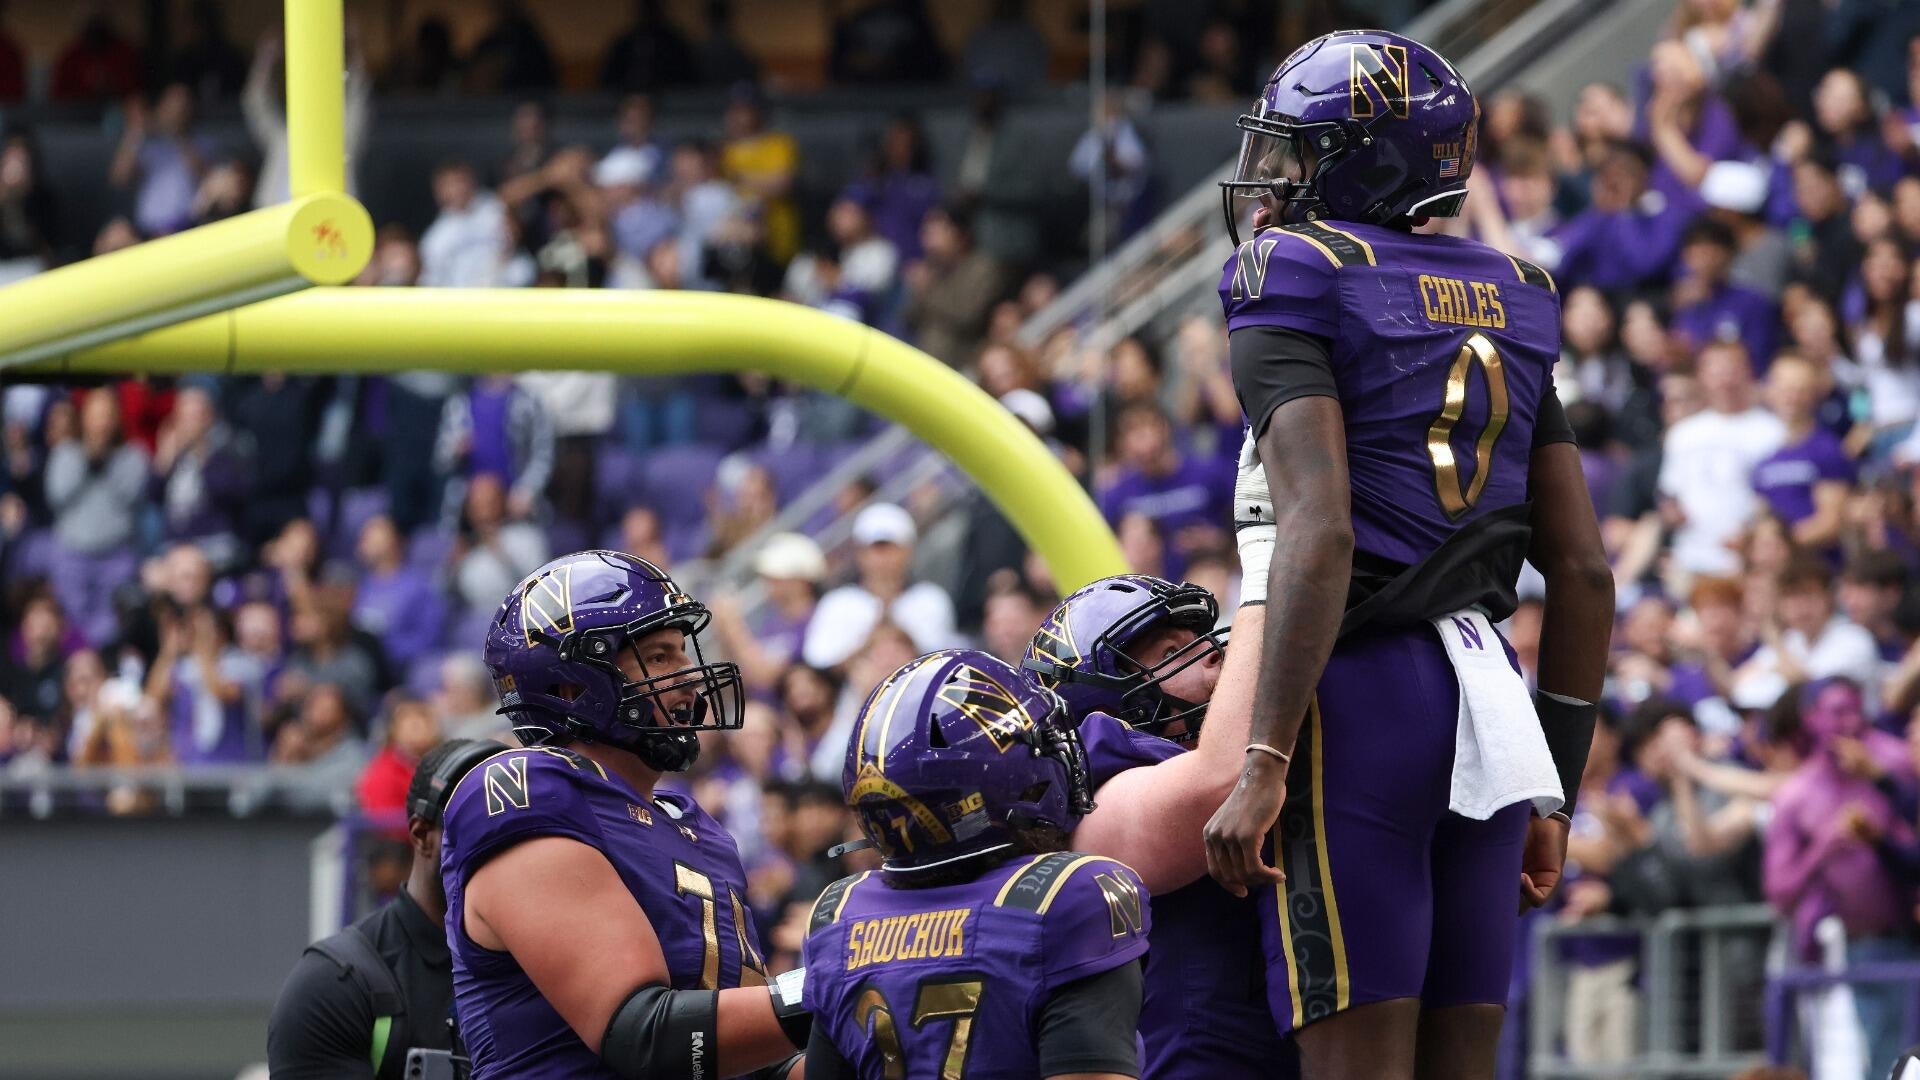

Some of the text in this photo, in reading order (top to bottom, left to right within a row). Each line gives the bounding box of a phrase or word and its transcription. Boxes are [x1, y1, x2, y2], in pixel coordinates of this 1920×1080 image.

[1349, 44, 1409, 119] N
[1231, 240, 1277, 300] N
[1418, 275, 1506, 329] CHILES
[1428, 331, 1510, 522] 0
[523, 565, 574, 648] N
[1451, 615, 1485, 652] N
[939, 665, 1033, 753] N
[486, 757, 530, 816] N
[1094, 870, 1143, 939] N
[848, 908, 972, 971] SAWCHUK
